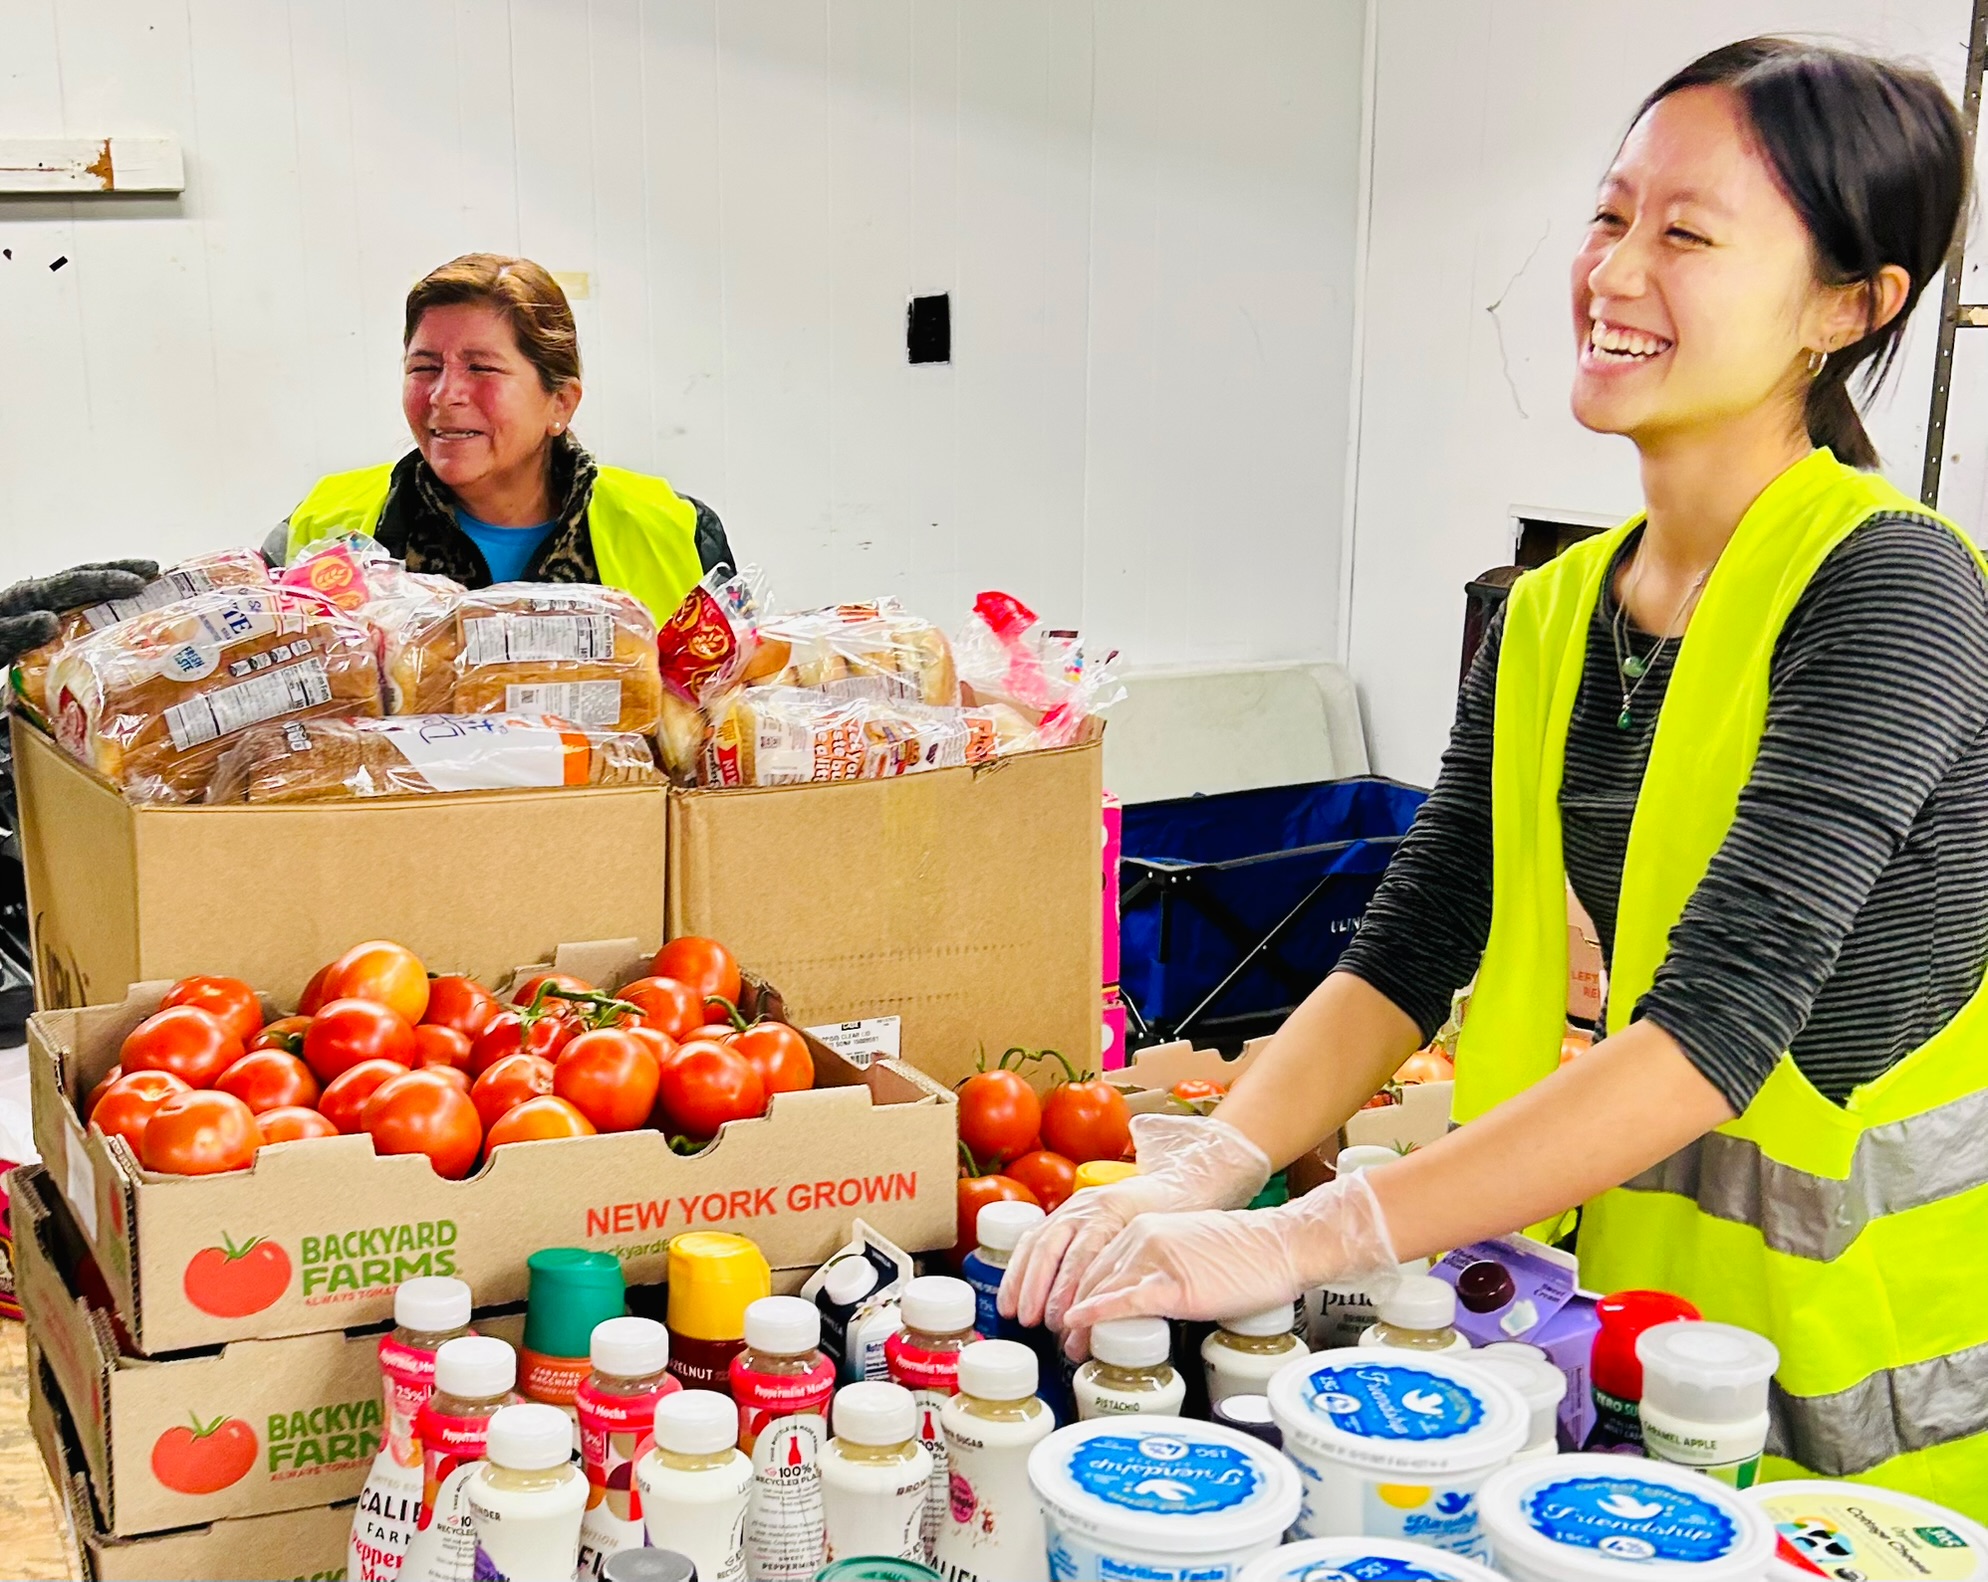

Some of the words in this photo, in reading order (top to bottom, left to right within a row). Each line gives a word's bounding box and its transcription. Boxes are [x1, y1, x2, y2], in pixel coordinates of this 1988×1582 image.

[181, 645, 205, 668] FRESH
[586, 1199, 670, 1237] NEW
[678, 1186, 778, 1225] YORK
[786, 1172, 918, 1213] GROWN
[302, 1219, 457, 1265] BACKYARD
[303, 1249, 456, 1296] FARMS
[529, 1373, 579, 1387] MACCHIAT
[1096, 1396, 1140, 1412] PISTACHIO
[1623, 1403, 1638, 1417] SU
[1684, 1437, 1717, 1450] APPLE
[756, 1475, 799, 1487] RECYCLED
[779, 1463, 812, 1478] 100%
[1089, 1459, 1244, 1486] Friendship
[1542, 1504, 1713, 1542] Friendship
[1846, 1506, 1891, 1540] Cottage
[1888, 1541, 1932, 1575] Cheese
